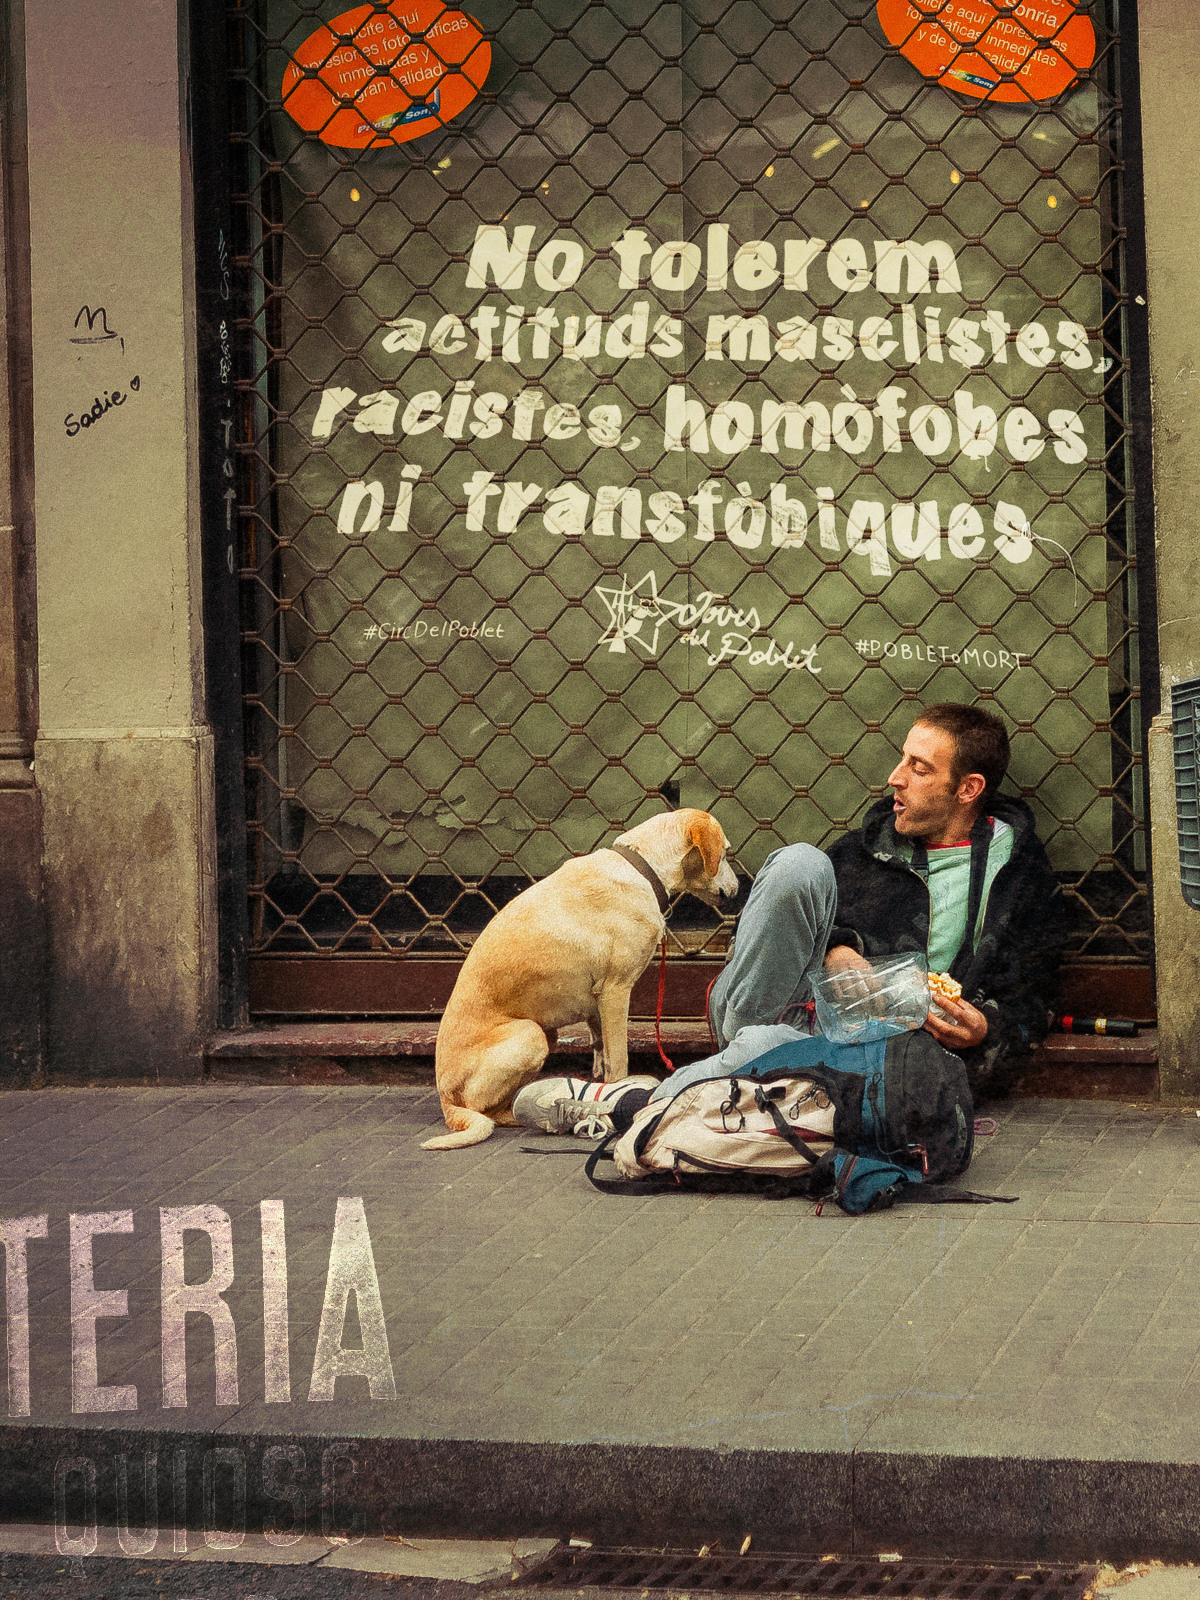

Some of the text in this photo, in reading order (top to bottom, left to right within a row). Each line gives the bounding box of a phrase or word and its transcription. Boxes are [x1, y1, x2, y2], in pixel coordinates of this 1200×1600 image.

[331, 22, 384, 46] Slcite
[382, 17, 469, 51] fotoáficas
[917, 29, 927, 42] y
[929, 33, 946, 47] de
[421, 48, 430, 63] y
[354, 81, 388, 103] gran
[465, 223, 963, 295] No tolerem
[382, 301, 1113, 374] actituds masclistes,
[64, 391, 127, 437] Sadie
[310, 380, 1089, 472] racistes, homòfobes
[337, 464, 1034, 576] ni transfòbiques
[363, 620, 505, 640] #CircDelPoblet
[707, 632, 822, 674] Poblet
[0, 1197, 398, 1417] TERIA
